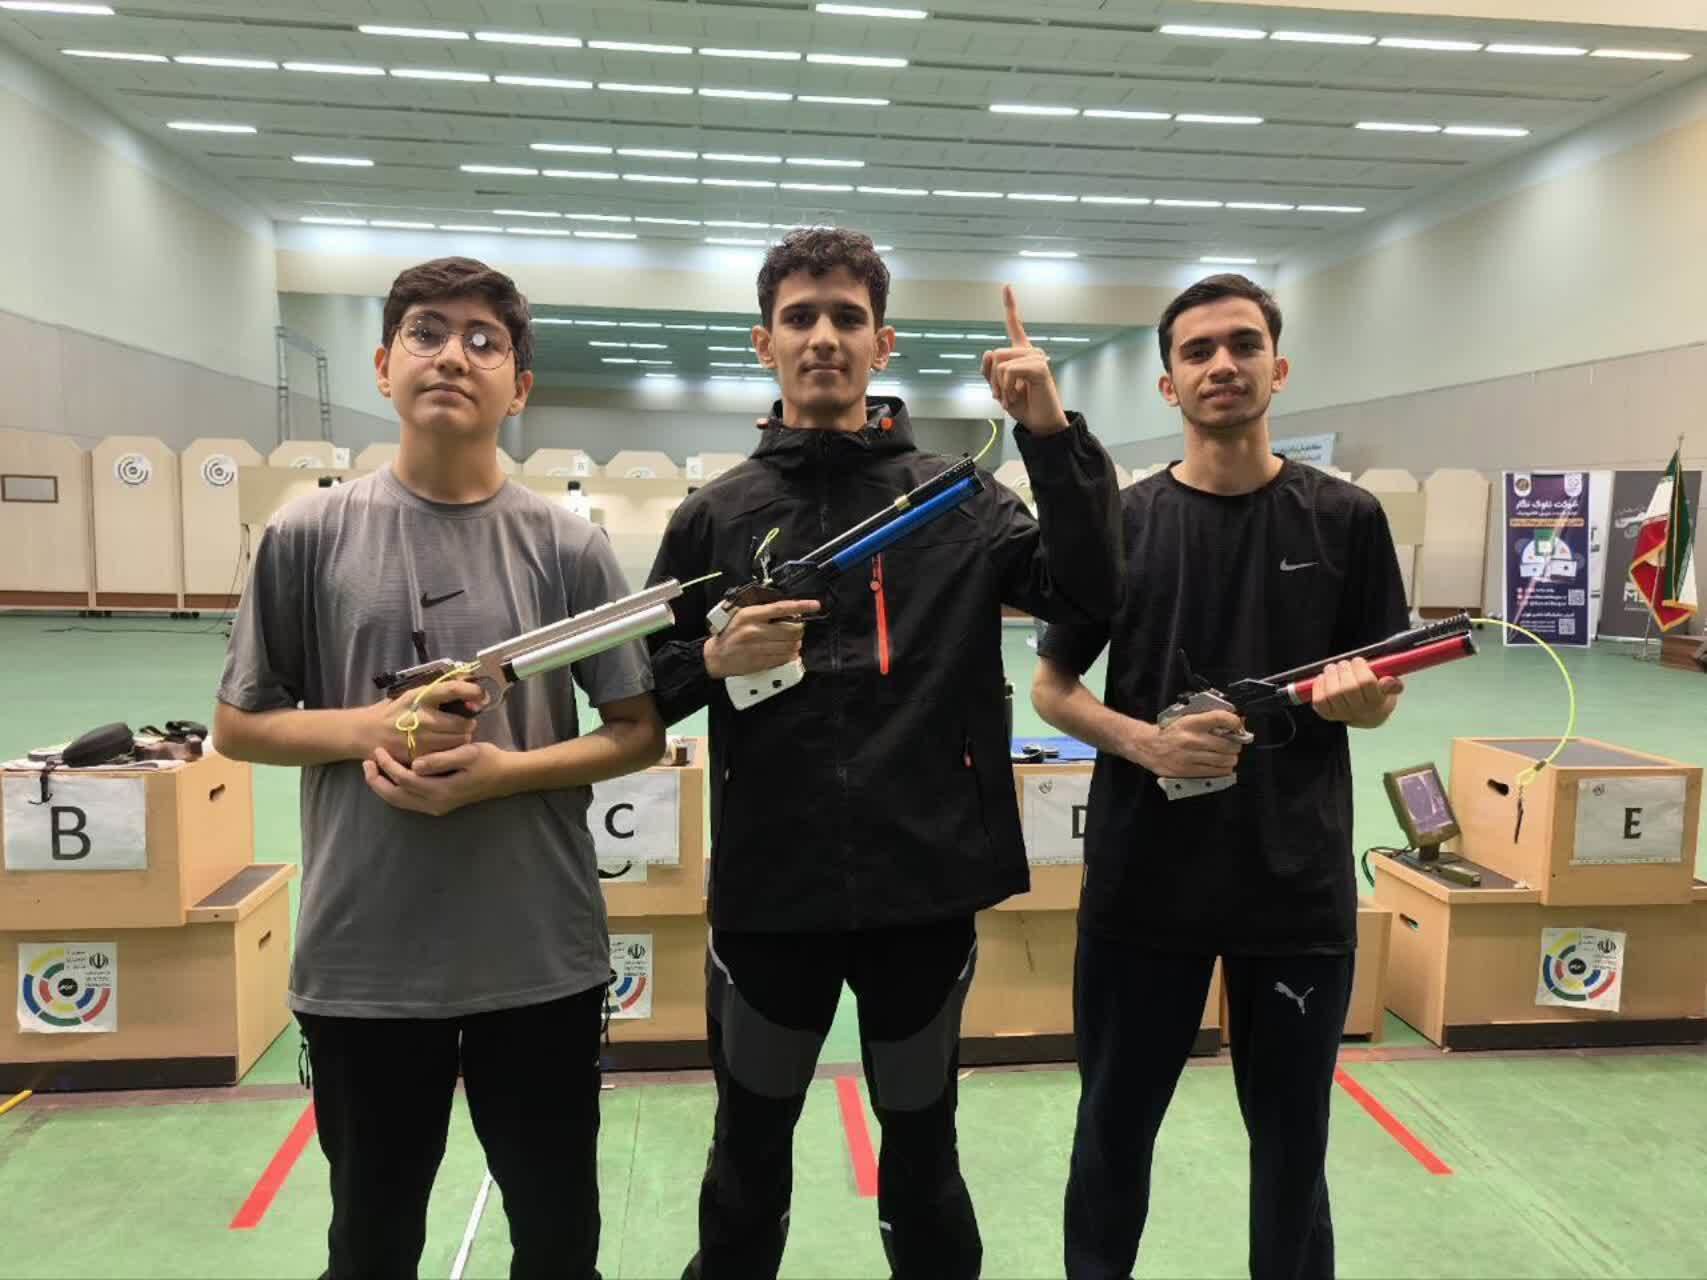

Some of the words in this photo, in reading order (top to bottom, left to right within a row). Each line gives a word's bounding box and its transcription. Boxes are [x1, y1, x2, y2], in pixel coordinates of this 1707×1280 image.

[51, 806, 91, 861] B
[605, 803, 634, 839] C
[1623, 807, 1643, 840] E
